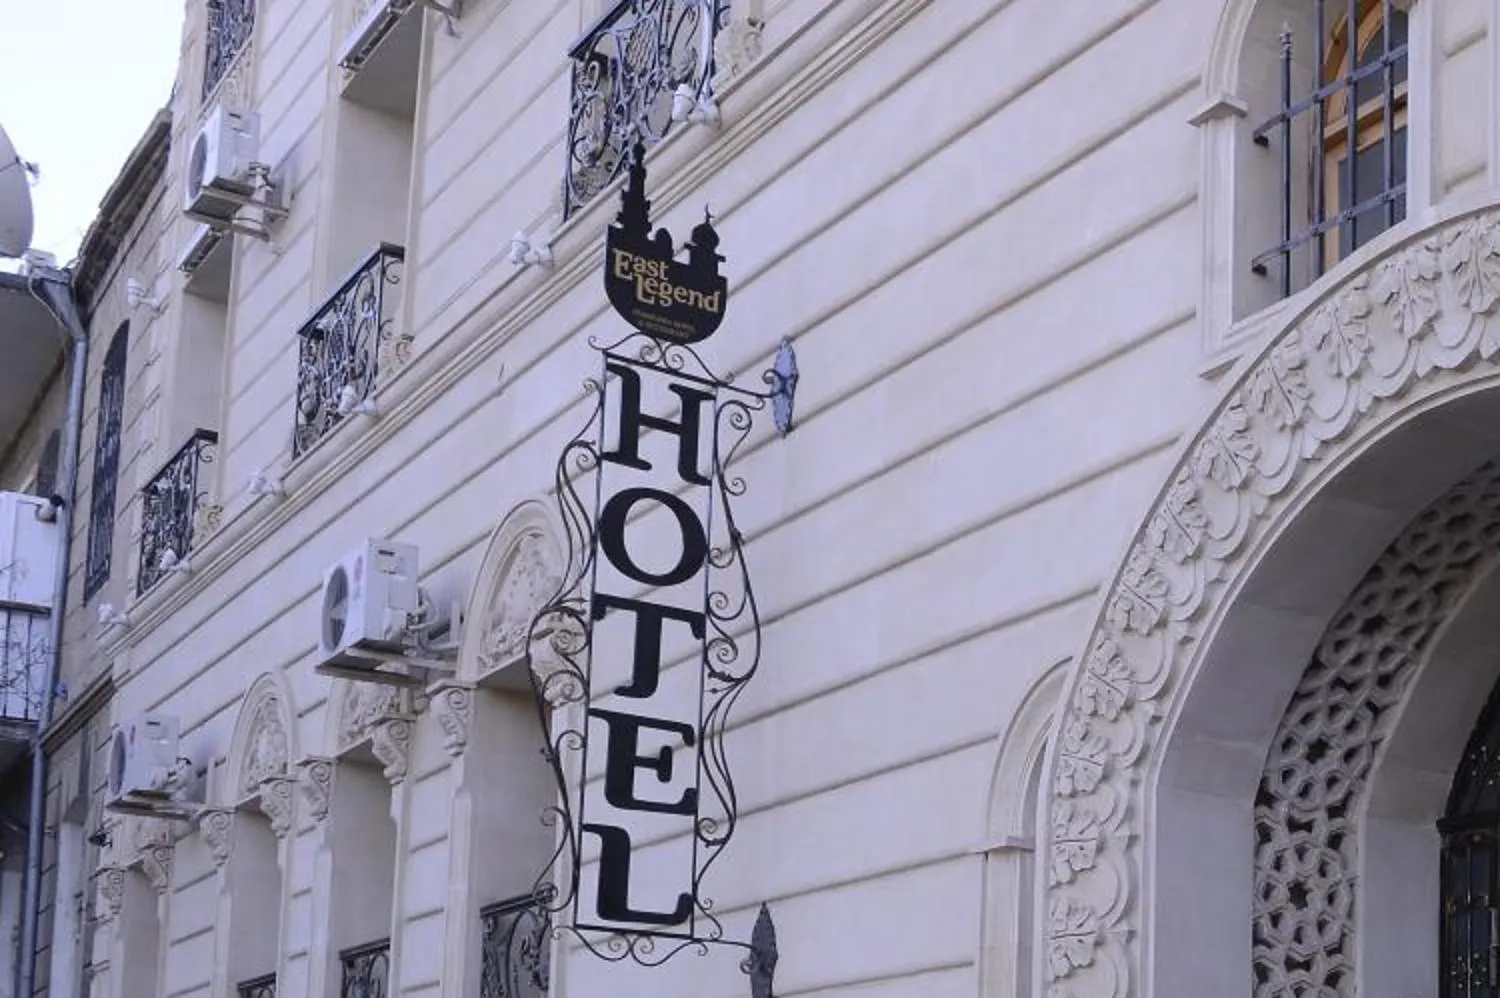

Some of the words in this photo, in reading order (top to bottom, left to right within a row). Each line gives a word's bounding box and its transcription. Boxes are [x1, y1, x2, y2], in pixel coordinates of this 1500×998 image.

[613, 249, 669, 281] East
[635, 274, 720, 313] Legend
[582, 361, 717, 925] HOTEL
